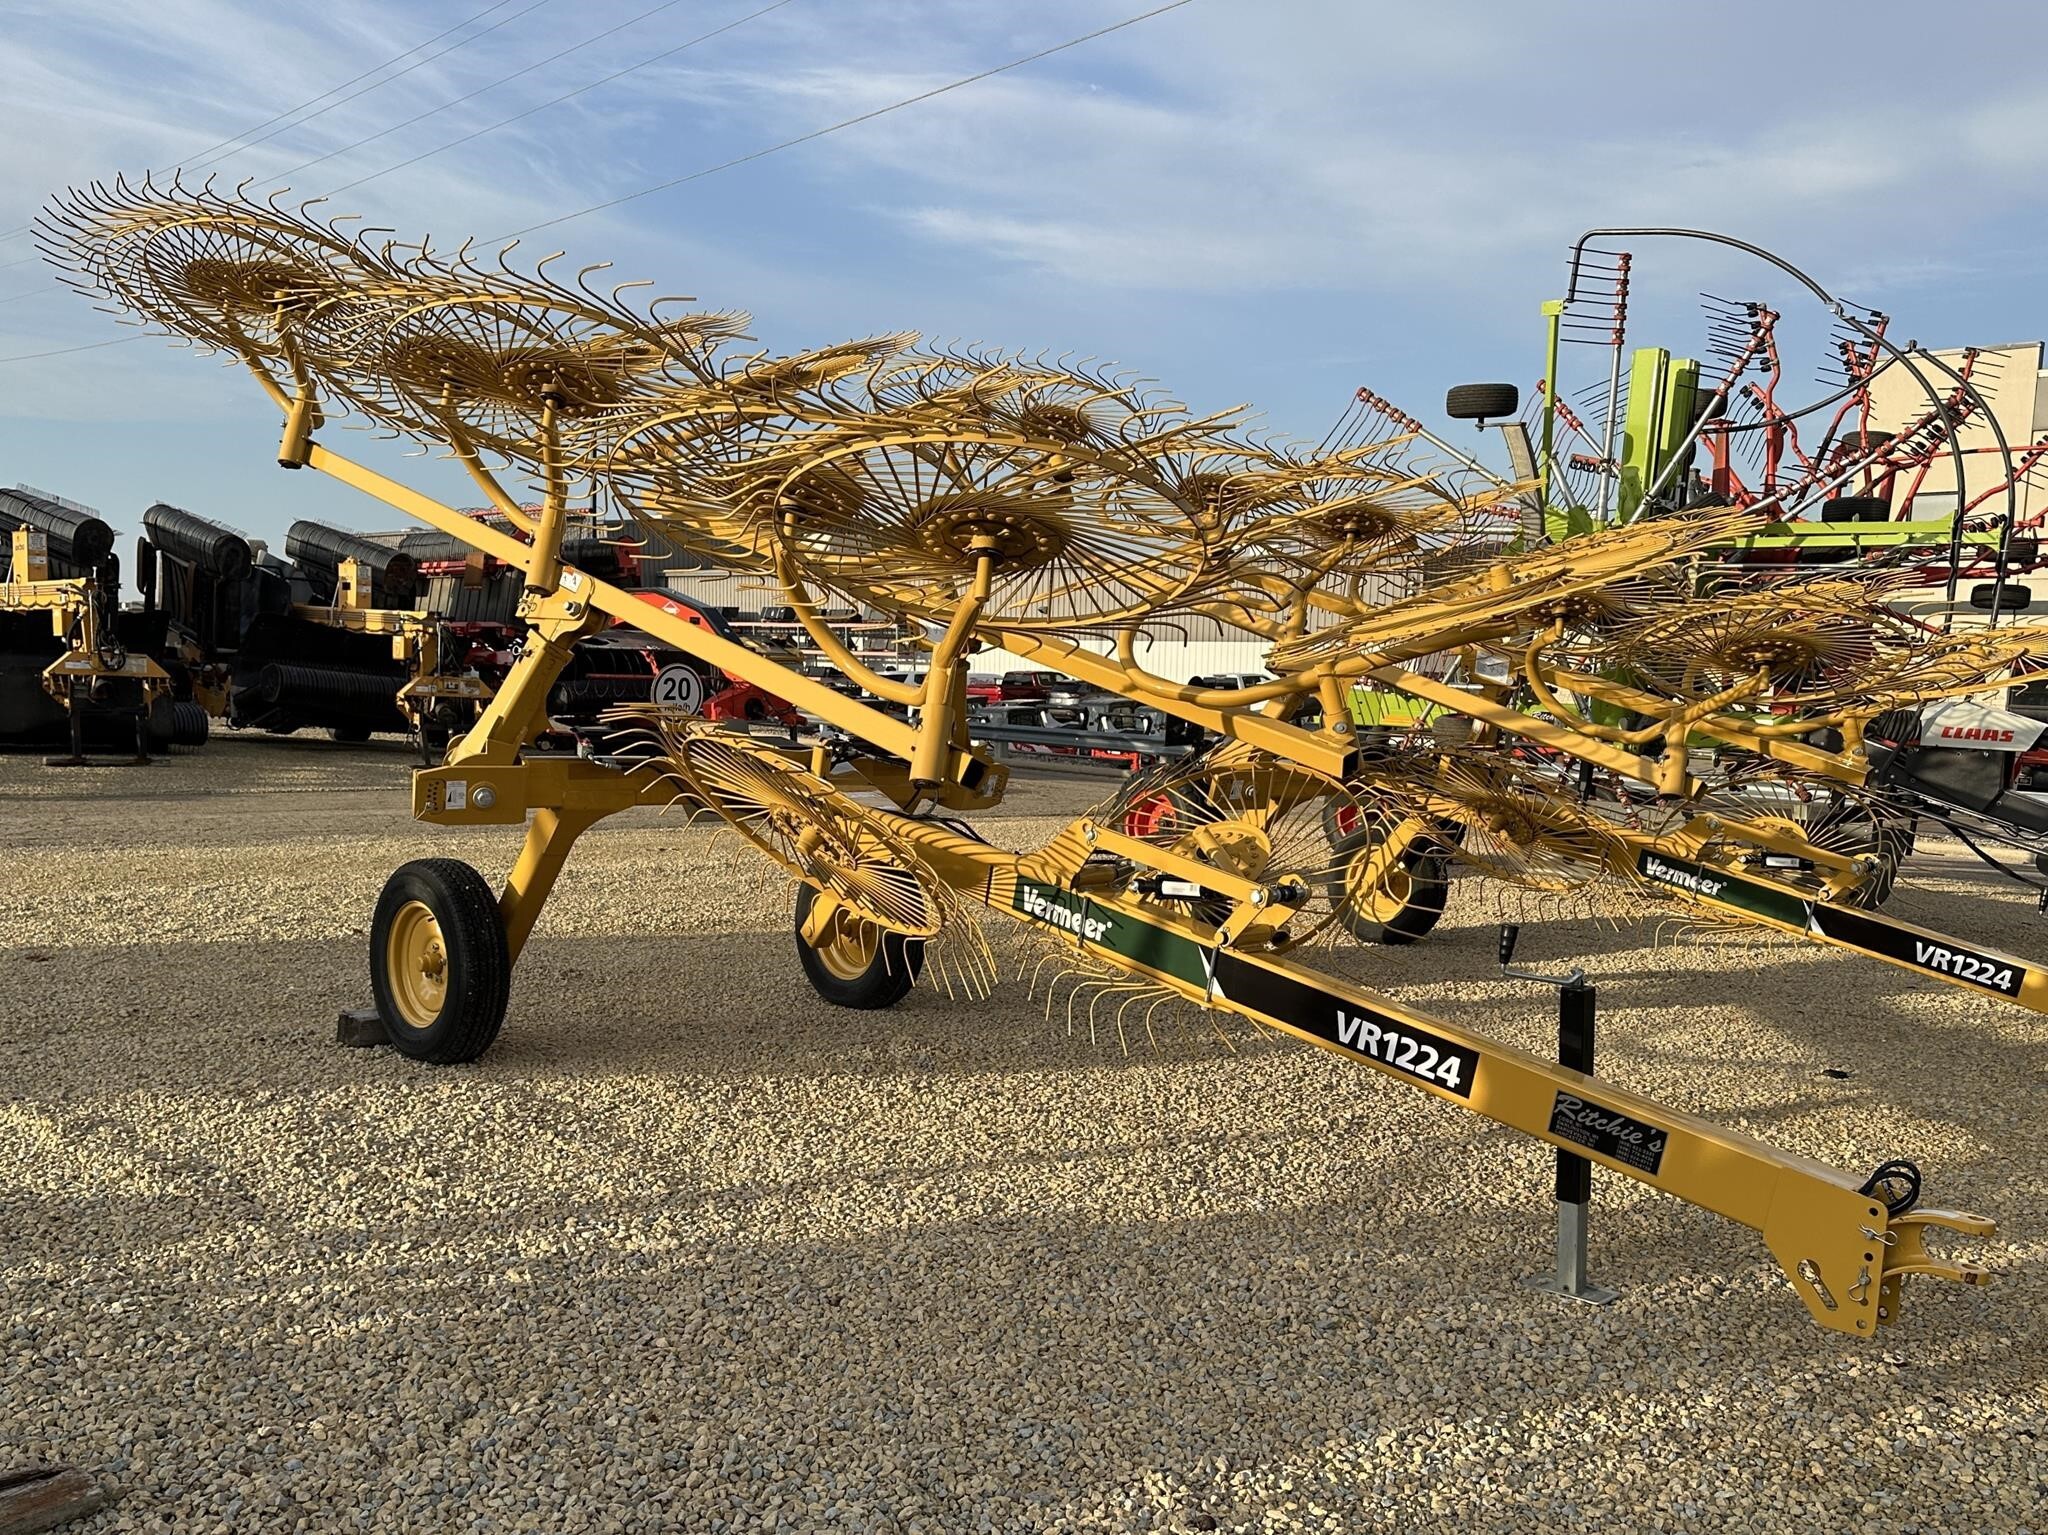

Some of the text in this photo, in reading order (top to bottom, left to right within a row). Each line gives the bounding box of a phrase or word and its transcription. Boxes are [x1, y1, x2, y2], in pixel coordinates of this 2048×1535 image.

[663, 677, 691, 701] 20
[1941, 726, 2015, 743] CLAAS
[1916, 941, 2013, 990] VR1224
[1337, 1010, 1461, 1089] VR1224
[1554, 1094, 1663, 1153] Ritchie's
